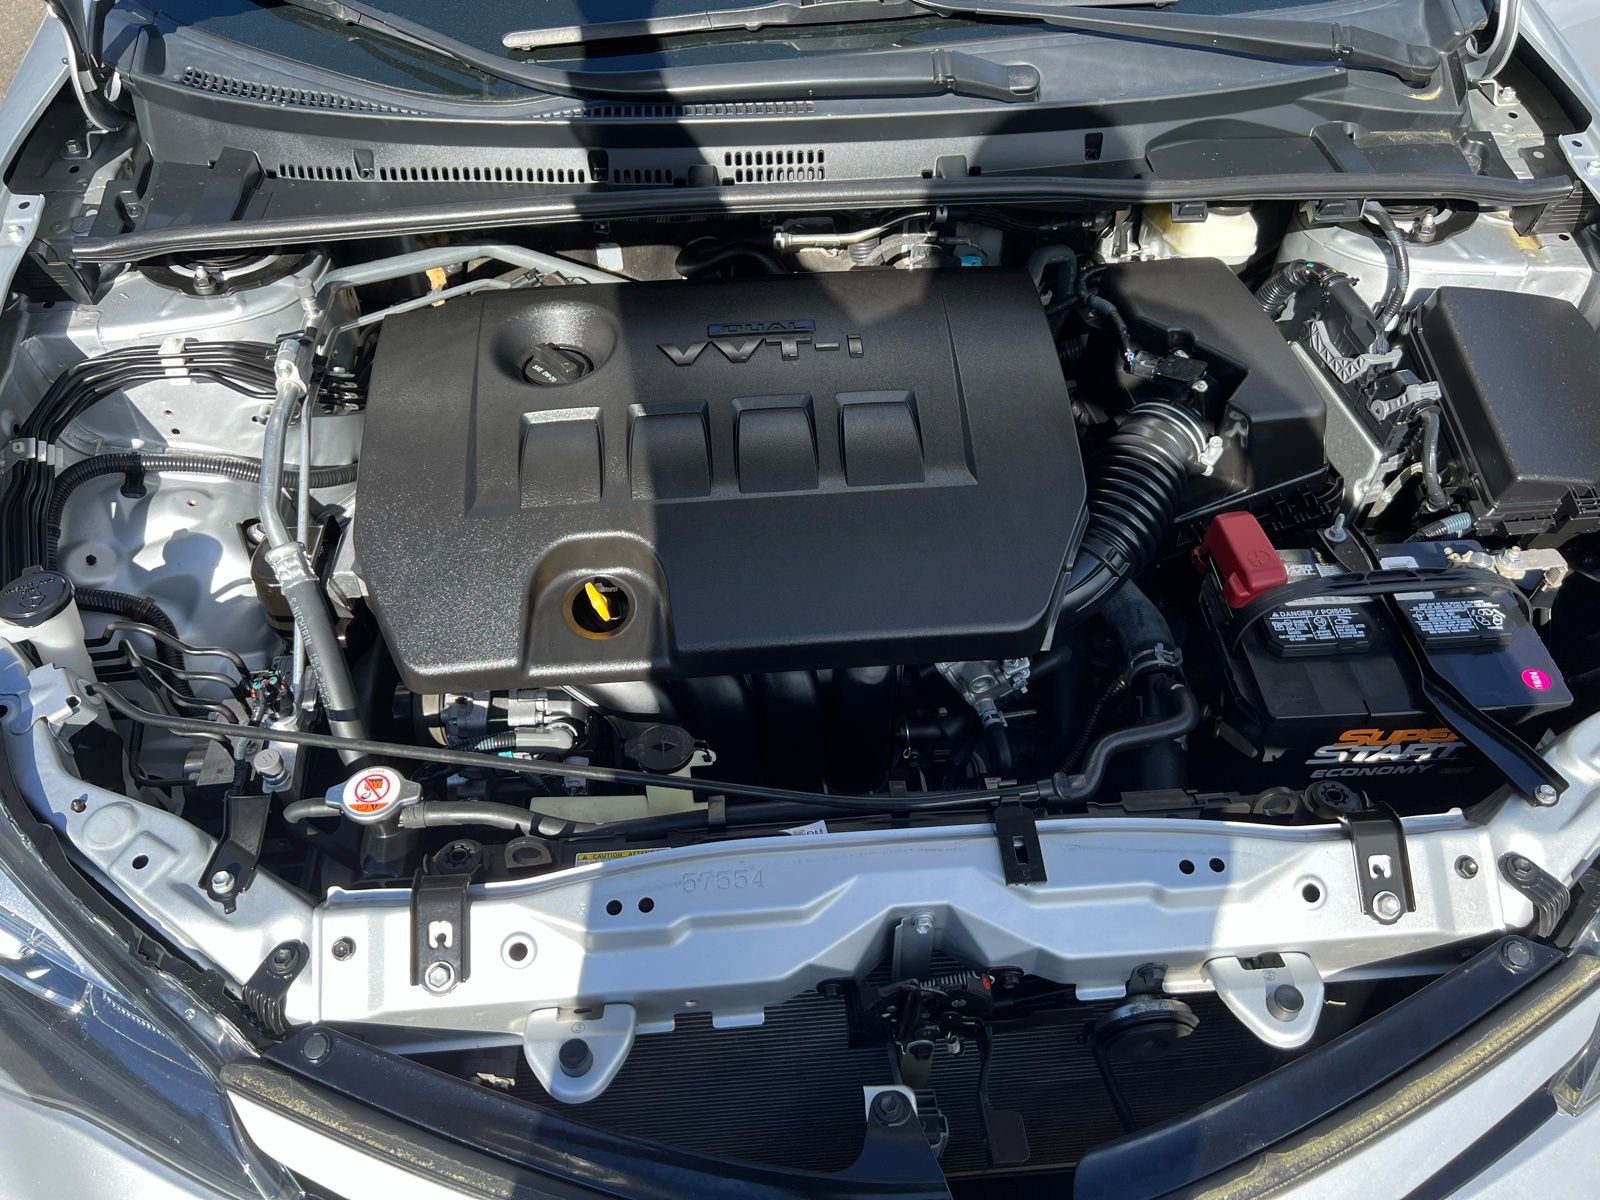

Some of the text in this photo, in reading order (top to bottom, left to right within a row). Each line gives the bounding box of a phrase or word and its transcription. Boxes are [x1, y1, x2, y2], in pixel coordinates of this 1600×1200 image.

[722, 321, 808, 332] DUAL
[532, 364, 544, 373] SAE
[1332, 728, 1459, 748] SUPE
[1304, 741, 1469, 765] START
[1310, 764, 1435, 779] ECONOMY
[592, 852, 623, 860] CAUTION
[682, 868, 766, 893] 57554
